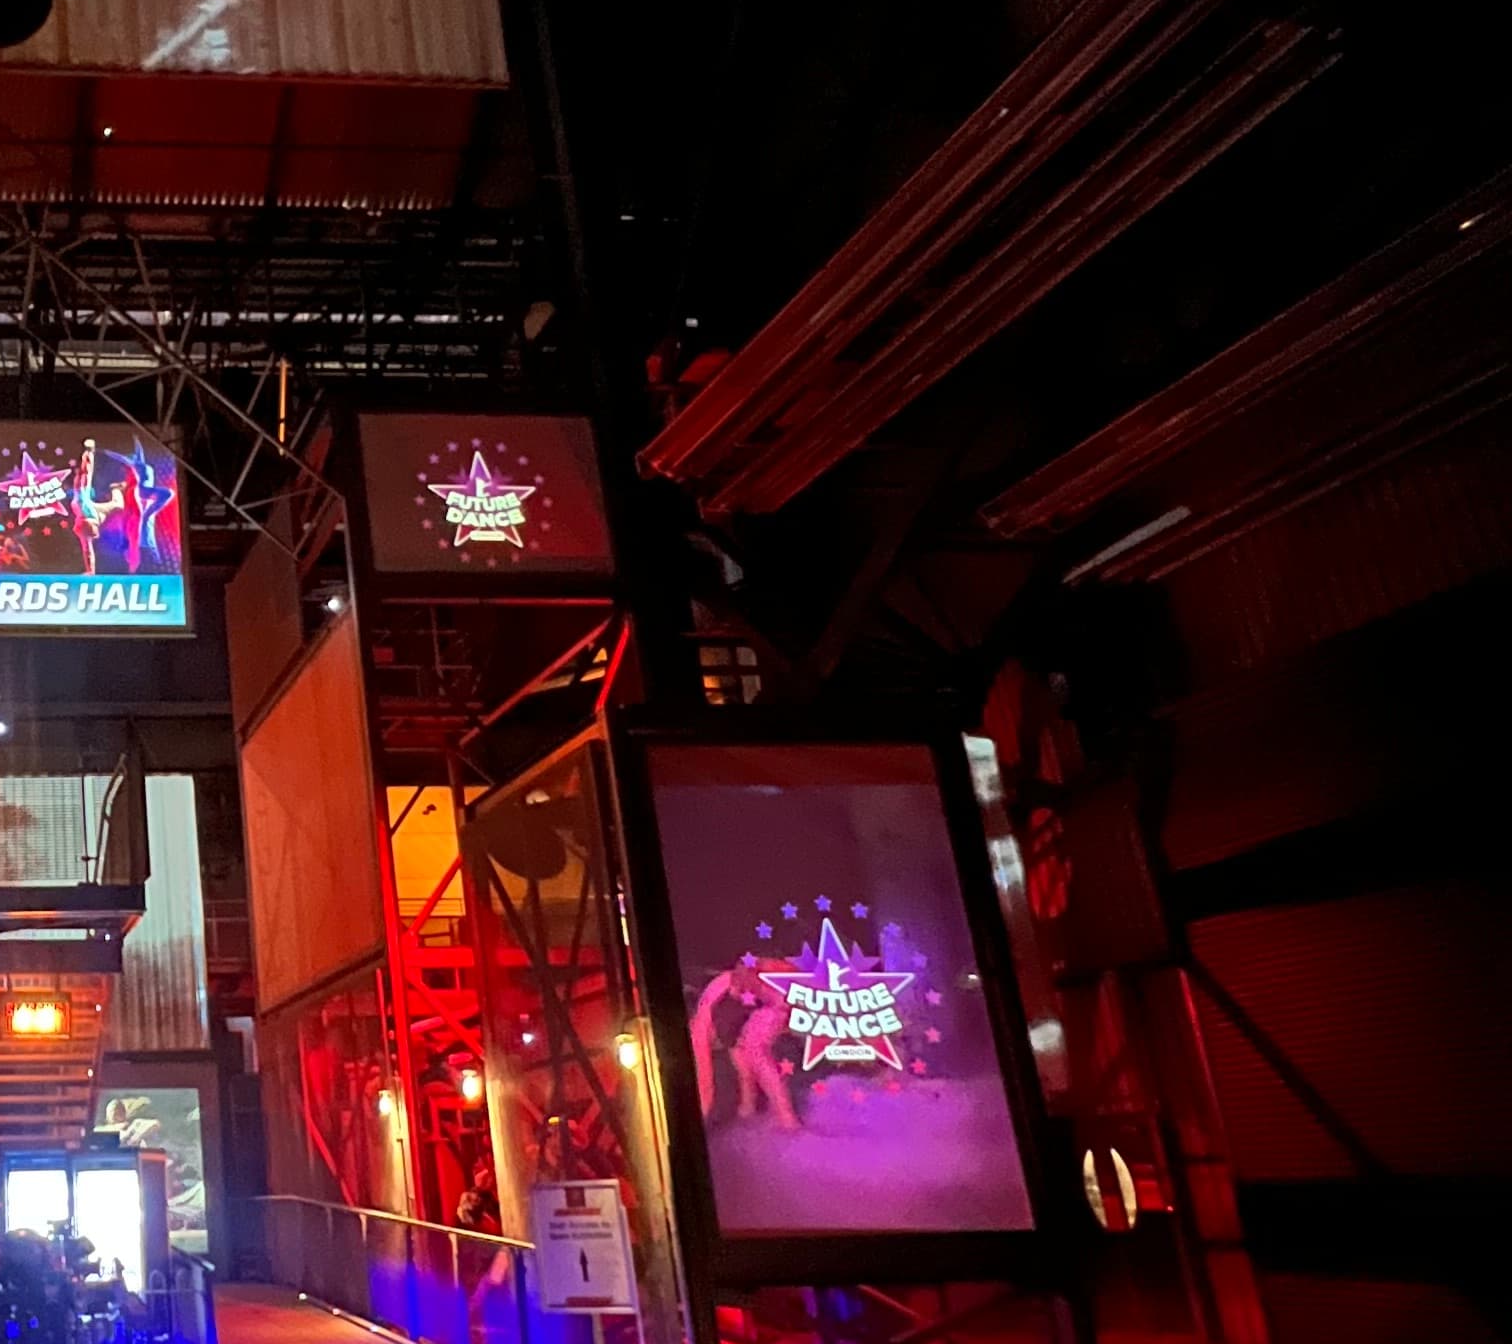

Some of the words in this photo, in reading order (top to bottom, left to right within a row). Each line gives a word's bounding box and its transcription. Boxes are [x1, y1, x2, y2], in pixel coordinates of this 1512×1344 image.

[8, 477, 62, 497] FUTURE
[446, 491, 521, 512] FUTURE
[446, 507, 526, 528] DANCE
[77, 583, 167, 611] HALL
[787, 982, 895, 1014] FUTURE
[789, 1007, 903, 1039] DANCE
